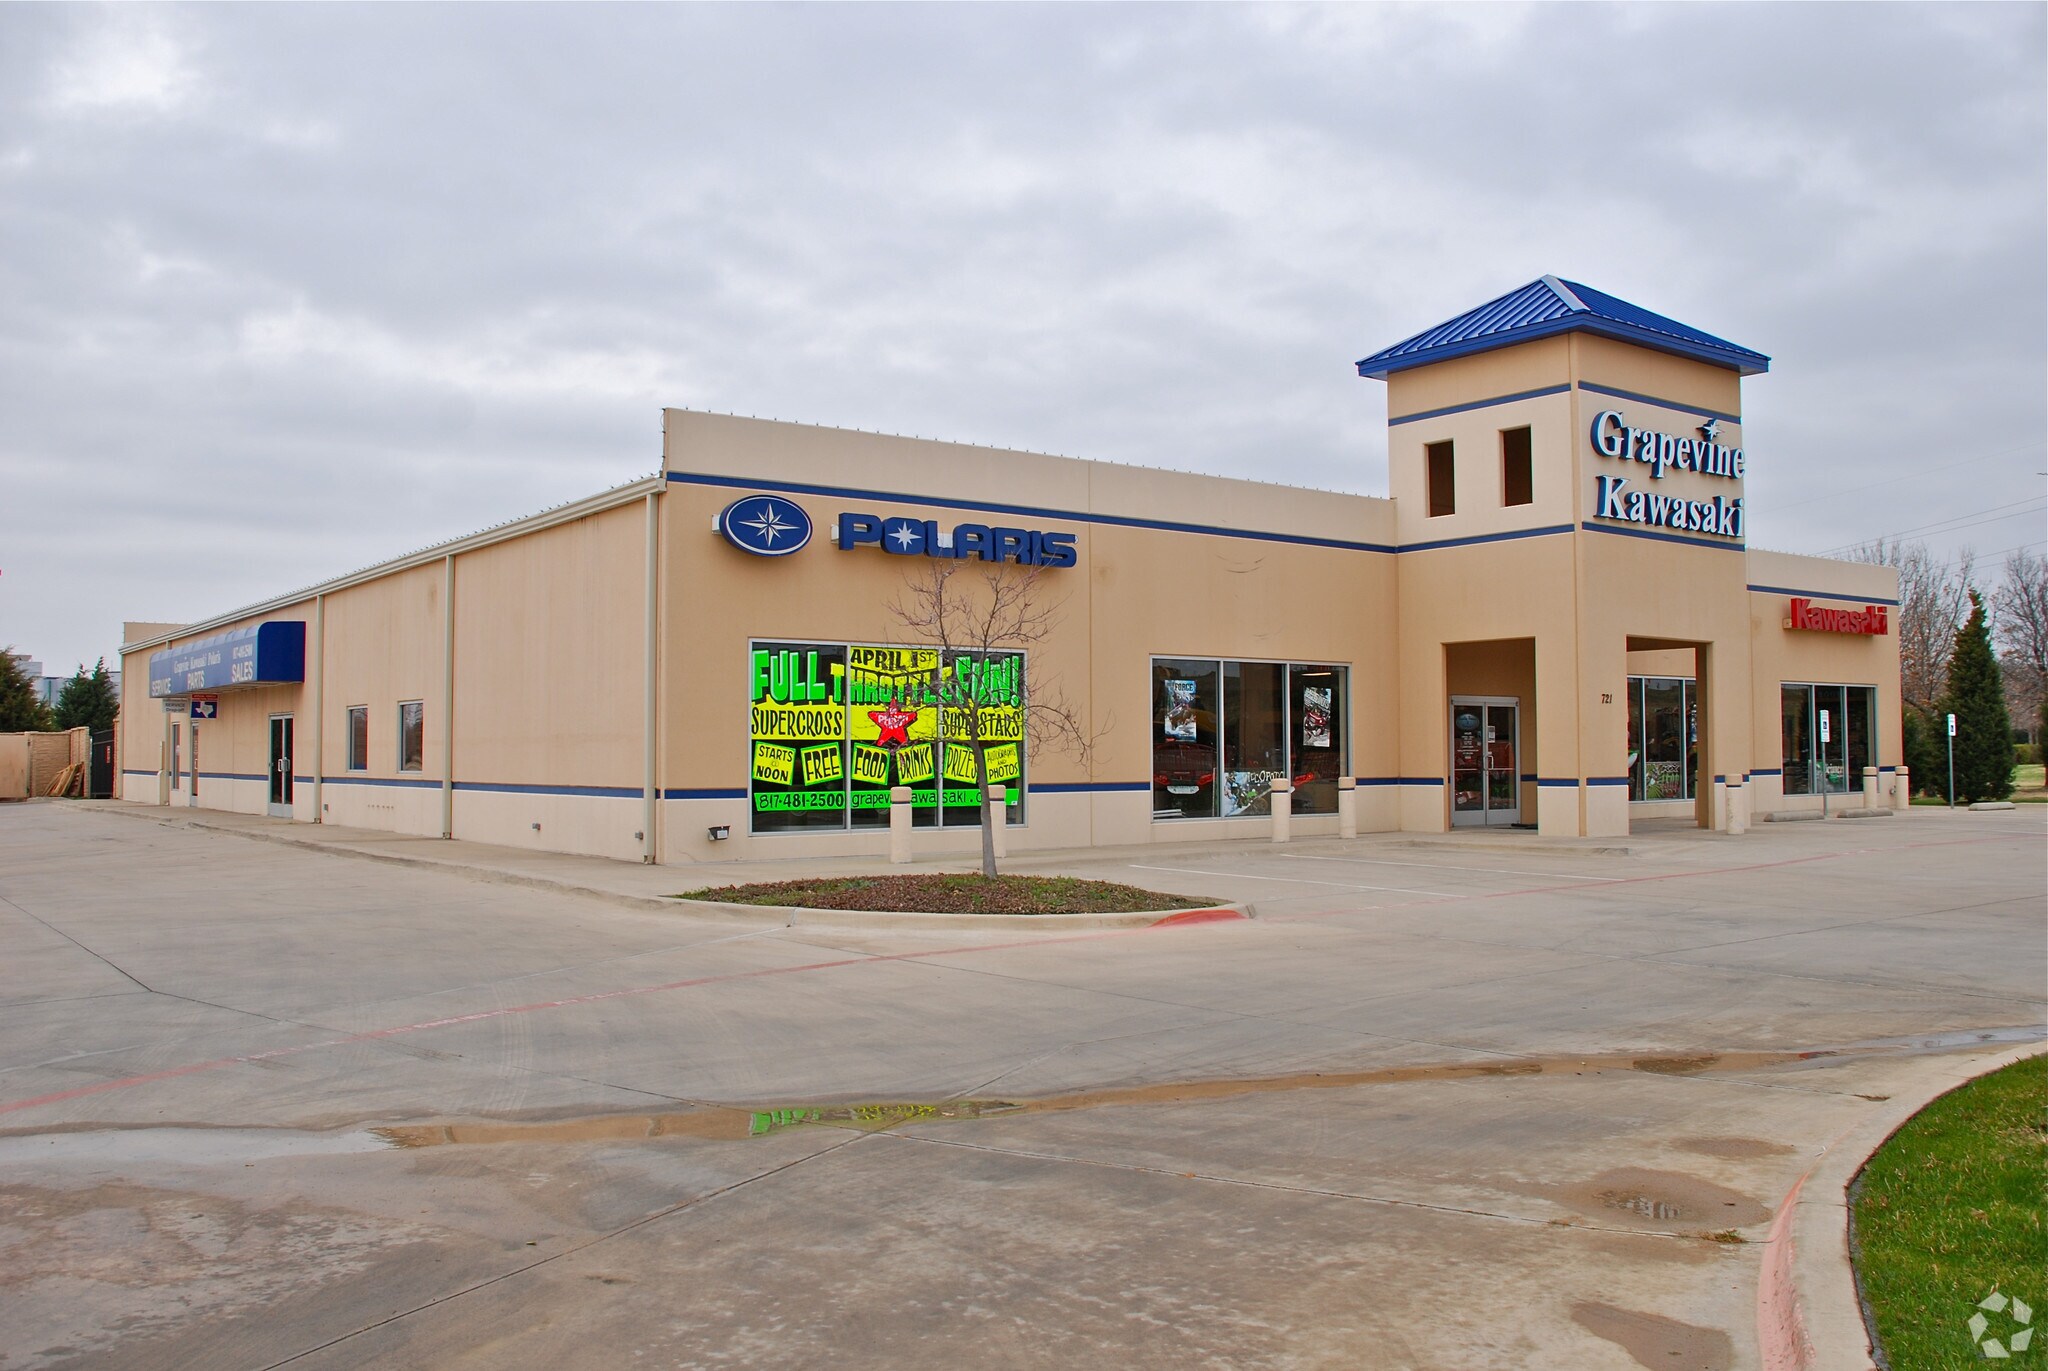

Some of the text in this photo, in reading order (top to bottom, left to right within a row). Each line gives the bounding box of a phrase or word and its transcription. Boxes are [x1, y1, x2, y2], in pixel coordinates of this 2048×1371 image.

[1591, 410, 1745, 479] Grapevine
[1593, 475, 1745, 538] Kawasaki
[838, 512, 1077, 567] POLARIS
[1790, 598, 1888, 635] Kawasaki
[231, 661, 253, 683] SALES
[850, 649, 935, 672] APRIL 1ST
[151, 677, 172, 696] SERVICE
[187, 670, 205, 690] PARTS
[752, 649, 826, 703] FULL
[1174, 683, 1194, 692] FORCE
[1601, 693, 1612, 704] 721
[751, 709, 843, 736] SUPERCROSS
[942, 709, 1021, 738] SUPESTARS
[758, 745, 793, 763] STARTS
[804, 747, 840, 781] FREE
[854, 750, 888, 778] FOOD
[900, 747, 934, 779] DRINKS
[755, 765, 789, 782] NOON
[988, 762, 1019, 780] PHOTOS
